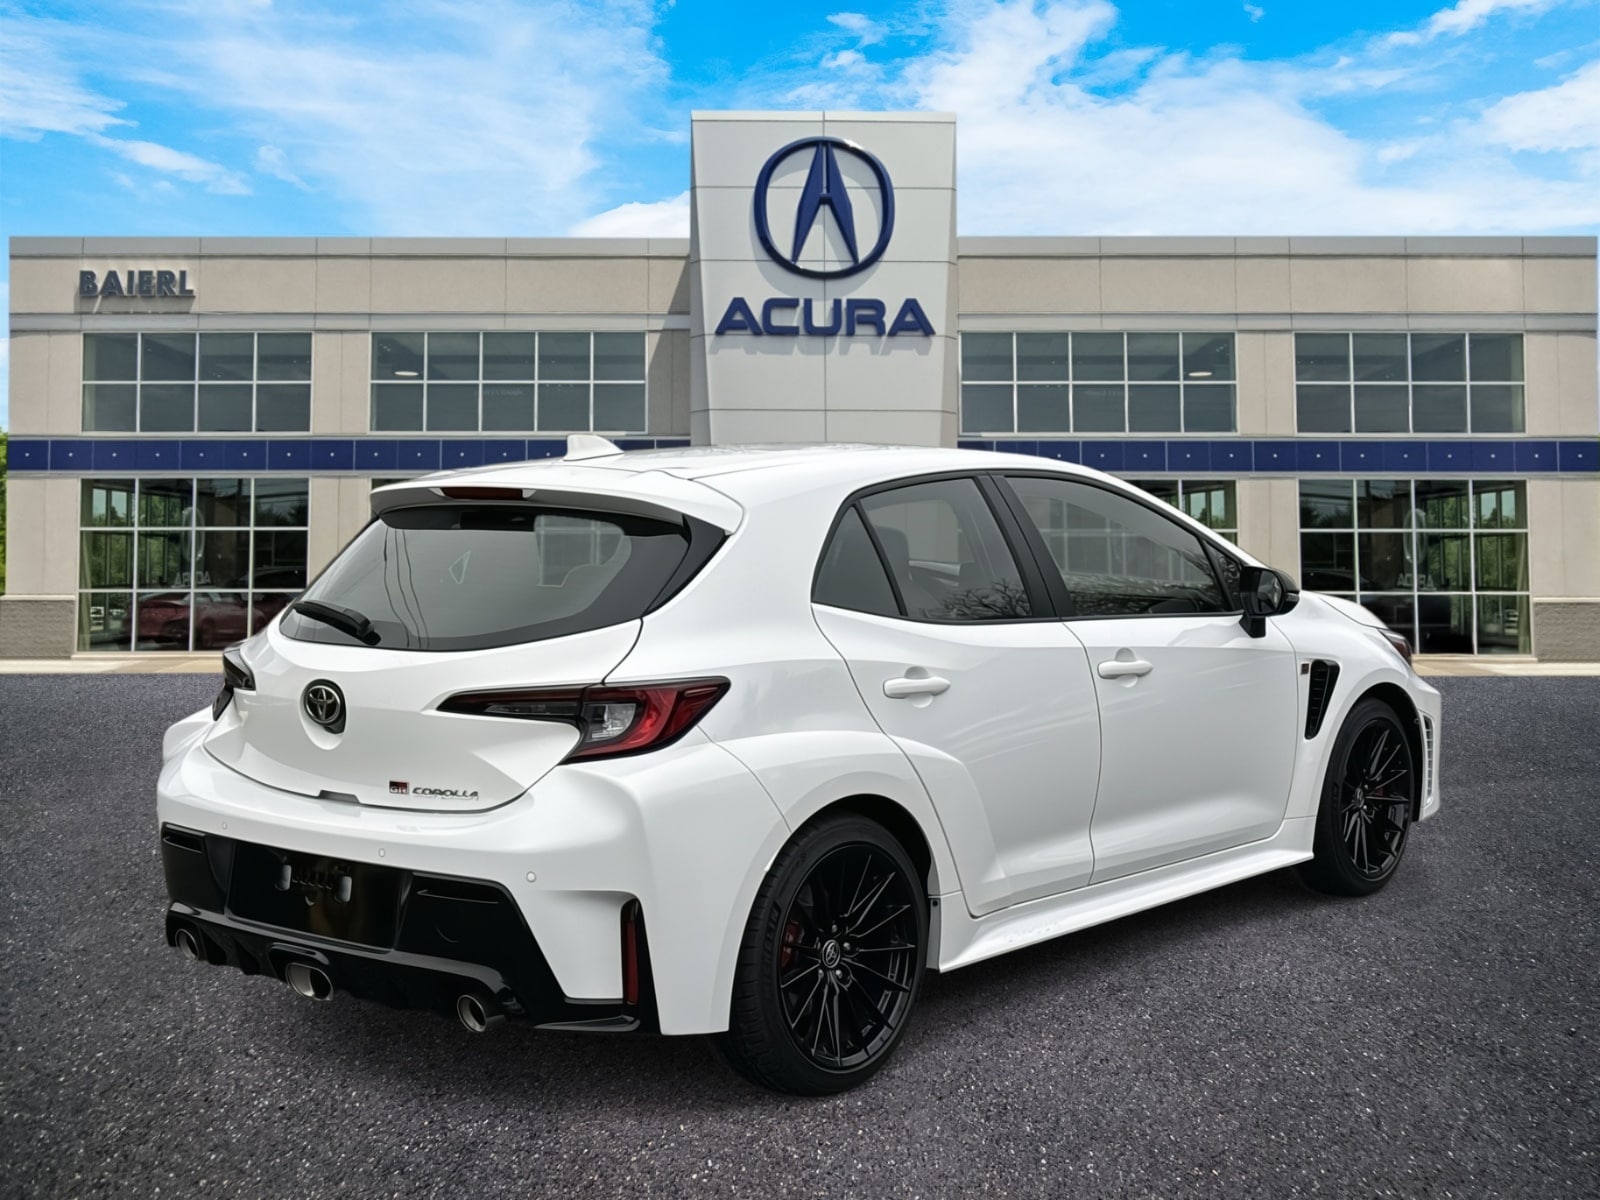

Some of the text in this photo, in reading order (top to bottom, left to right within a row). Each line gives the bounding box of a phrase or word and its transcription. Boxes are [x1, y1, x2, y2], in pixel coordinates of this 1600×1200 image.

[79, 270, 196, 297] BAIERL
[715, 297, 936, 337] ACURA
[389, 784, 480, 799] GR COROLLA
